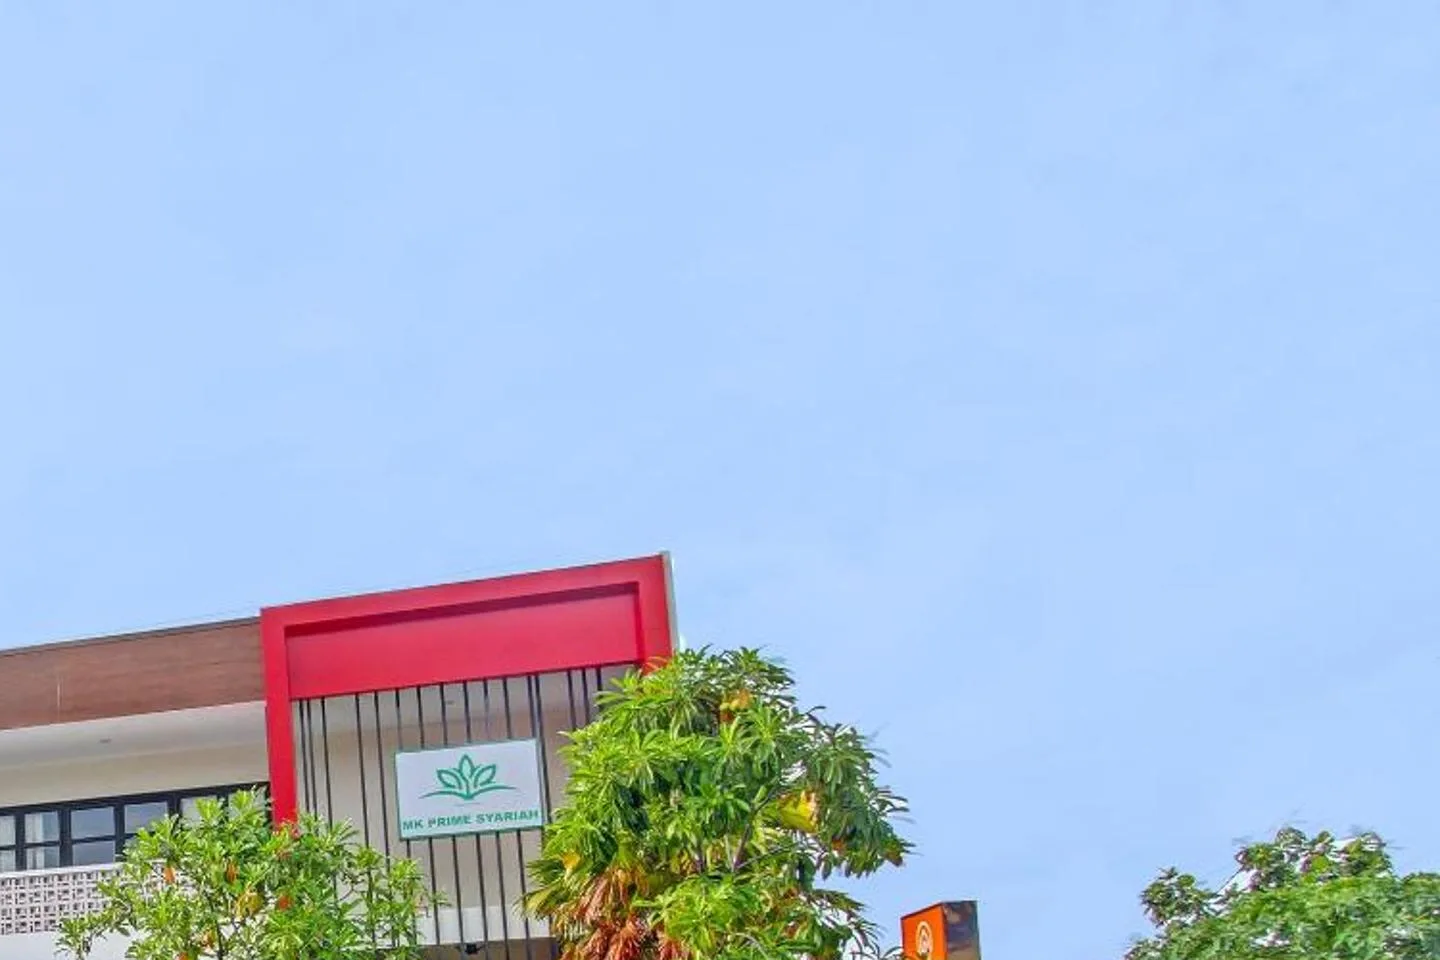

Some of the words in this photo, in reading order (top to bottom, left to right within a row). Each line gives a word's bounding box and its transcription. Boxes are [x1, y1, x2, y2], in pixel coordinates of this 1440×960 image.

[402, 819, 424, 830] MK
[427, 815, 472, 827] PRIME
[476, 809, 539, 824] SYARIAH
